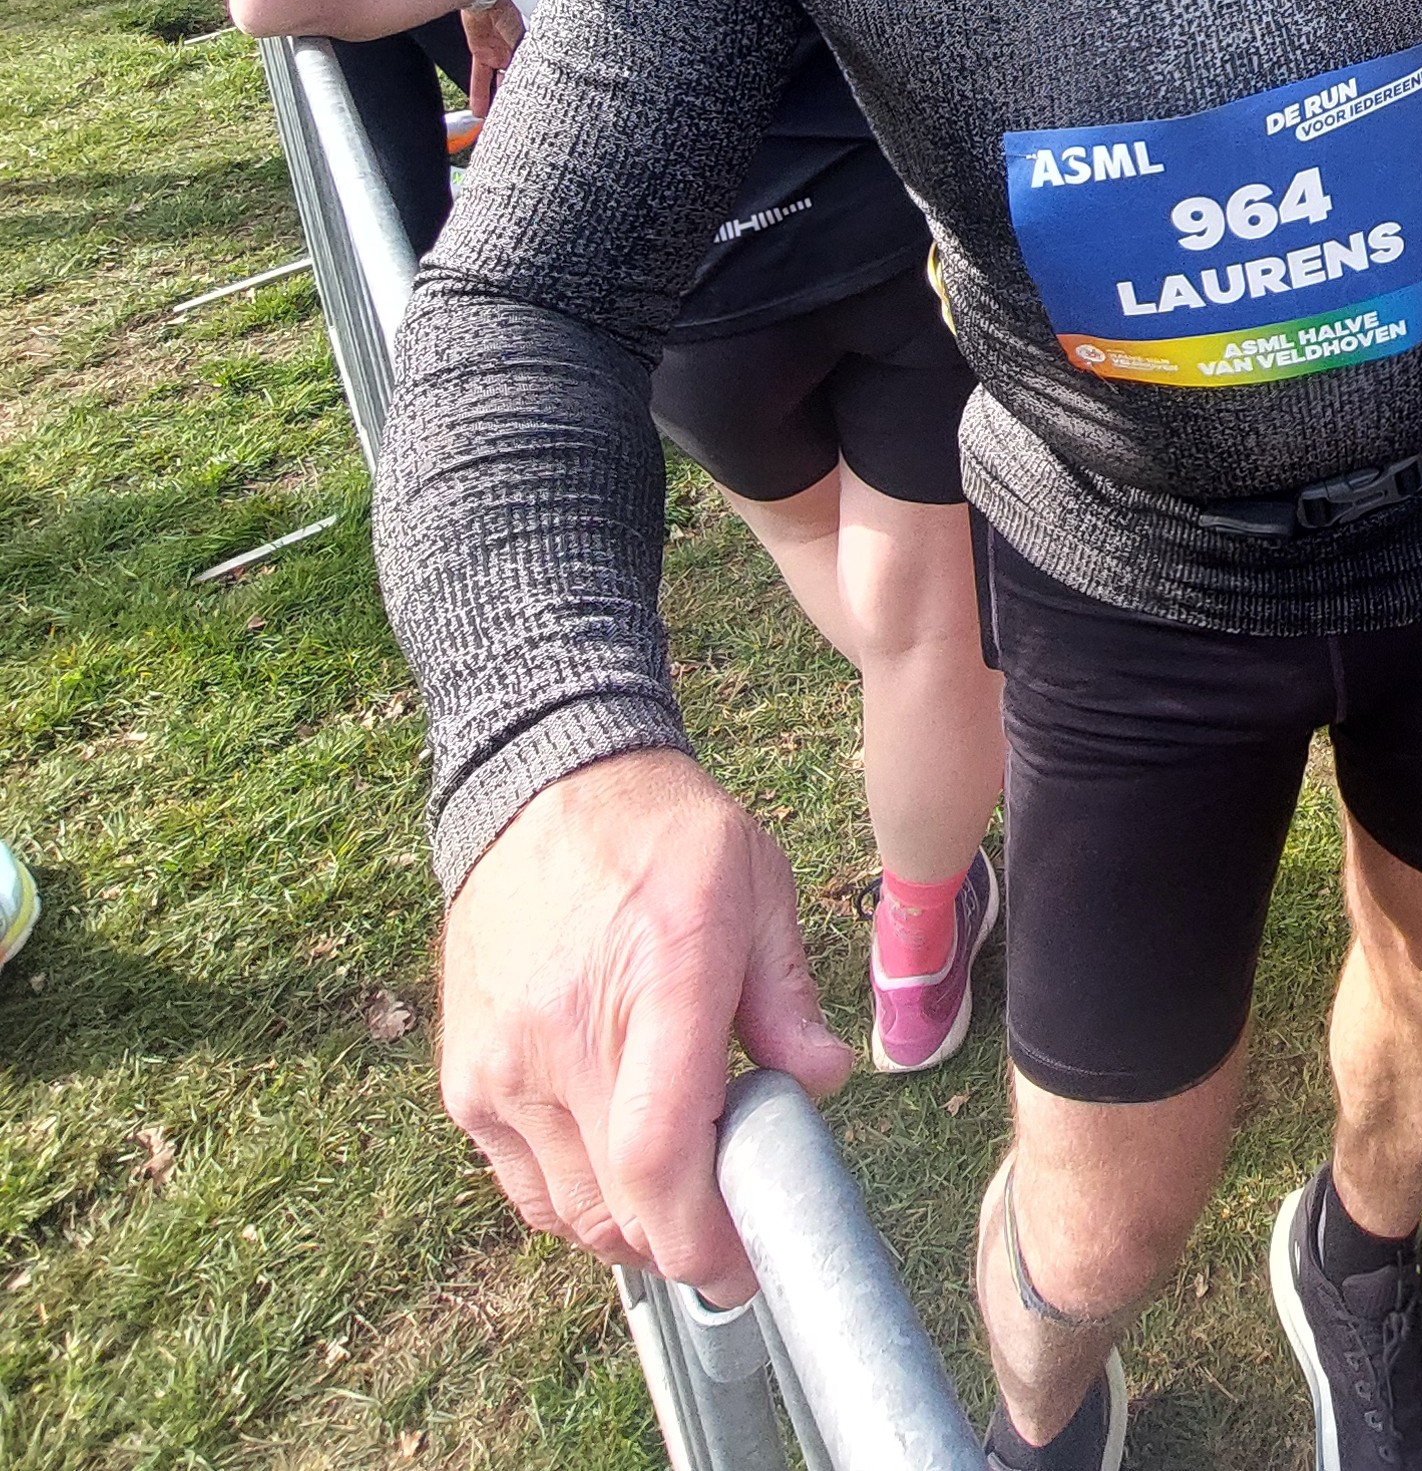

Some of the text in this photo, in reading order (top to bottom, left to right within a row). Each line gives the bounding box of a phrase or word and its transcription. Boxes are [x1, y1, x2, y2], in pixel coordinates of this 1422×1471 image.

[1266, 78, 1357, 135] DE RUN
[1302, 110, 1346, 137] VOOR
[1030, 140, 1164, 188] ASML
[1171, 167, 1333, 251] 964
[1116, 221, 1405, 316] LAURENS
[1197, 357, 1253, 376] VAN
[1256, 320, 1408, 369] VELDHOVEN
[1224, 310, 1380, 359] ASML HALVE
